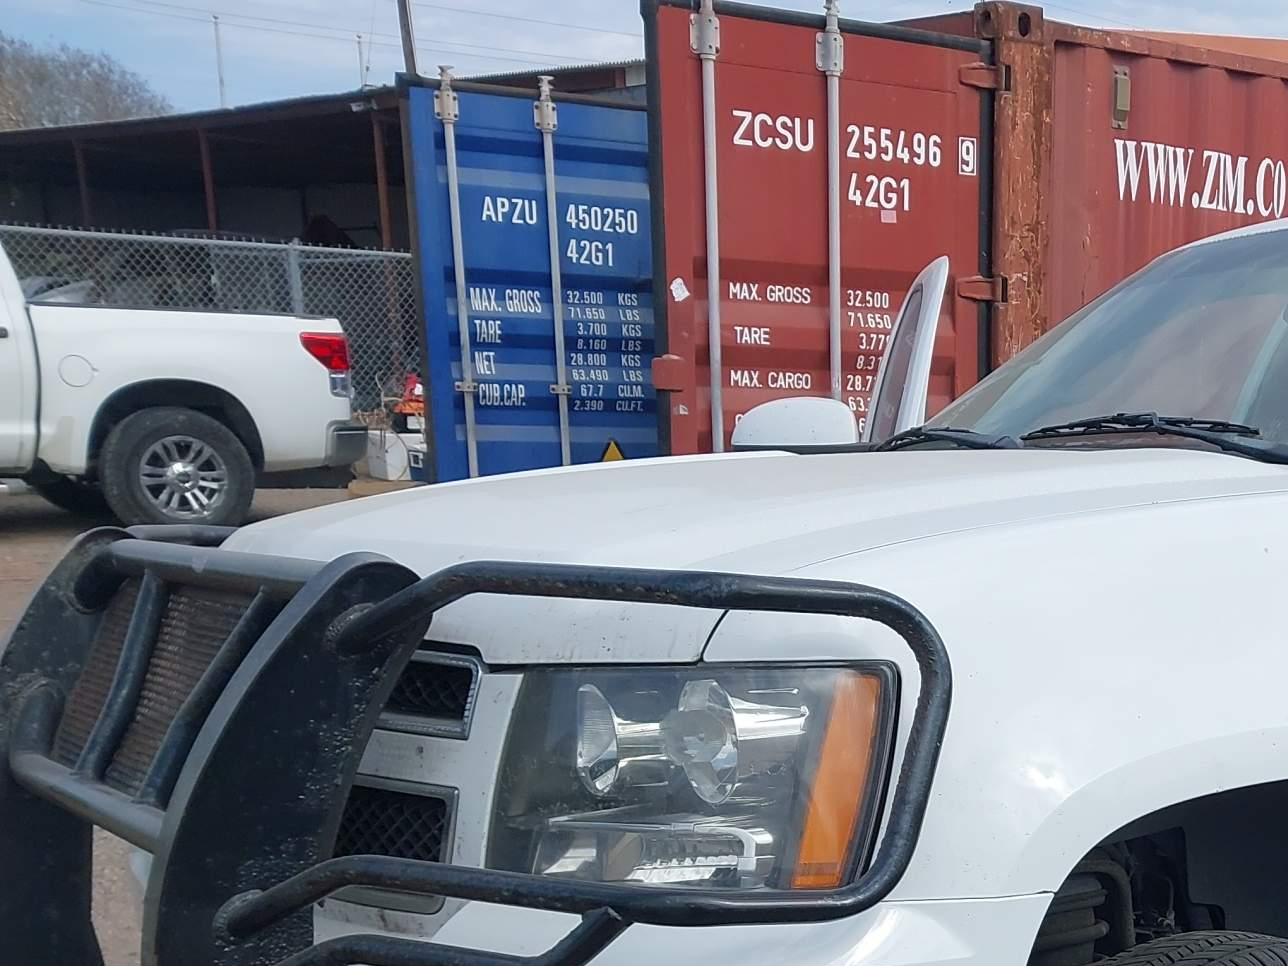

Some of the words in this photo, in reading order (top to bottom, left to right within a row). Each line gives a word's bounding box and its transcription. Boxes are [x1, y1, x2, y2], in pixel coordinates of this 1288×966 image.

[732, 109, 814, 152] ZCSU
[846, 124, 942, 168] 255496
[960, 139, 975, 173] 9
[848, 172, 910, 211] 42G1
[481, 196, 537, 225] APZU
[566, 204, 638, 234] 450250
[566, 239, 614, 267] 42G1
[469, 288, 502, 312] MAX.
[505, 289, 542, 313] GROSS
[566, 290, 603, 305] 32.500
[617, 293, 638, 306] KGS
[729, 282, 762, 301] MAX.
[767, 285, 811, 304] GROSS
[847, 290, 889, 309] 32.500
[568, 306, 606, 320] 71.650
[619, 309, 640, 321] LBS
[847, 311, 892, 329] 71.650
[474, 320, 502, 344] TARE
[577, 323, 607, 336] 3.700
[621, 325, 642, 337] KGS
[734, 326, 770, 345] TARE
[577, 339, 607, 350] 8.160
[621, 340, 641, 351] LBS
[475, 351, 496, 375] NET
[570, 353, 607, 366] 28.800
[621, 355, 641, 367] KGS
[572, 369, 609, 381] 63.490
[623, 370, 643, 382] LBS
[730, 369, 762, 388] MAX.
[768, 372, 811, 389] CARGO
[846, 374, 877, 391] 28.7
[479, 383, 526, 407] CUB.CAP.
[580, 384, 604, 398] 67.7
[573, 400, 604, 411] 2.390
